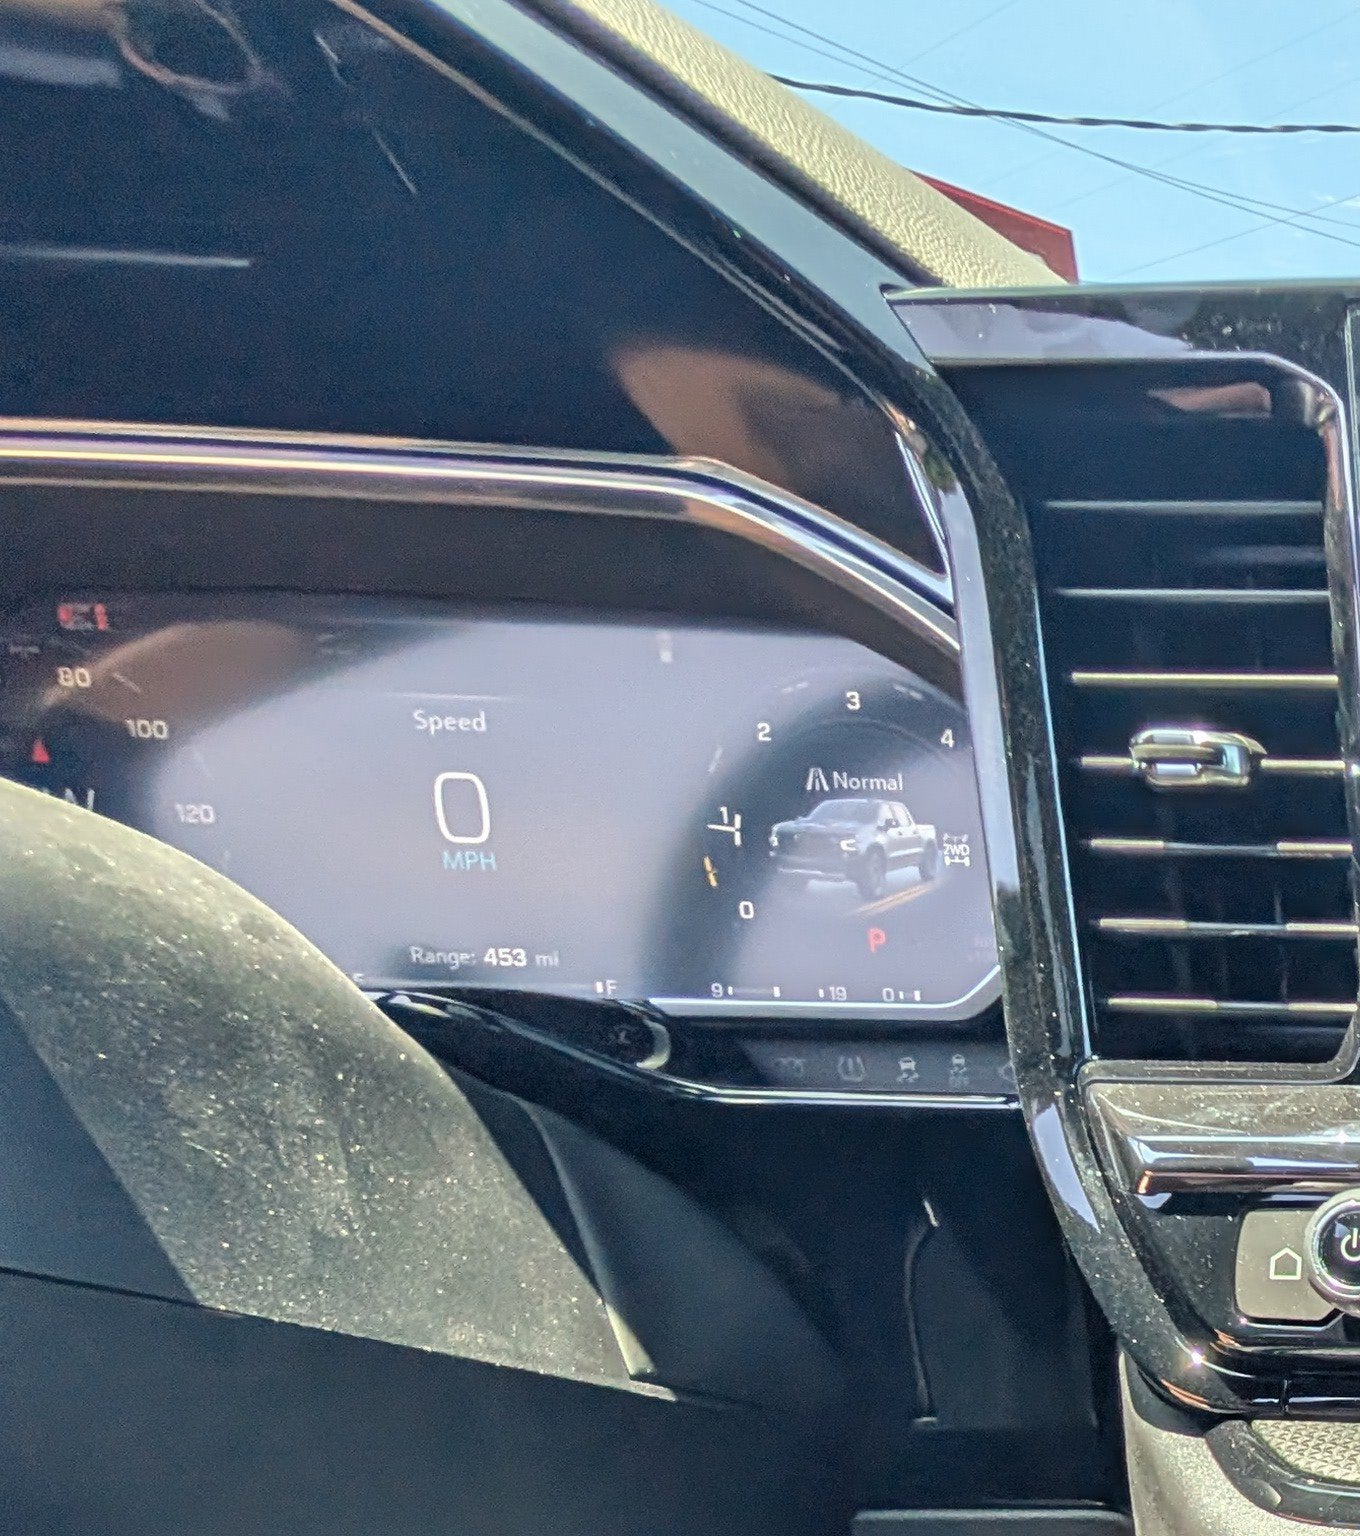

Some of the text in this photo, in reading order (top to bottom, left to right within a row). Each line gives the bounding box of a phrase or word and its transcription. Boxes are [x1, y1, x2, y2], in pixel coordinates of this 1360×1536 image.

[56, 666, 92, 688] 80
[846, 691, 861, 711] 3
[124, 719, 169, 740] 100
[413, 710, 487, 734] Speed
[757, 722, 772, 742] 2
[940, 728, 955, 748] 4
[832, 770, 904, 792] Normal
[175, 804, 216, 824] 120
[434, 771, 491, 844] 0
[442, 851, 497, 872] MPH
[738, 900, 756, 919] 0
[867, 927, 886, 953] P
[409, 945, 560, 969] Range: 453 mi
[605, 979, 618, 997] F
